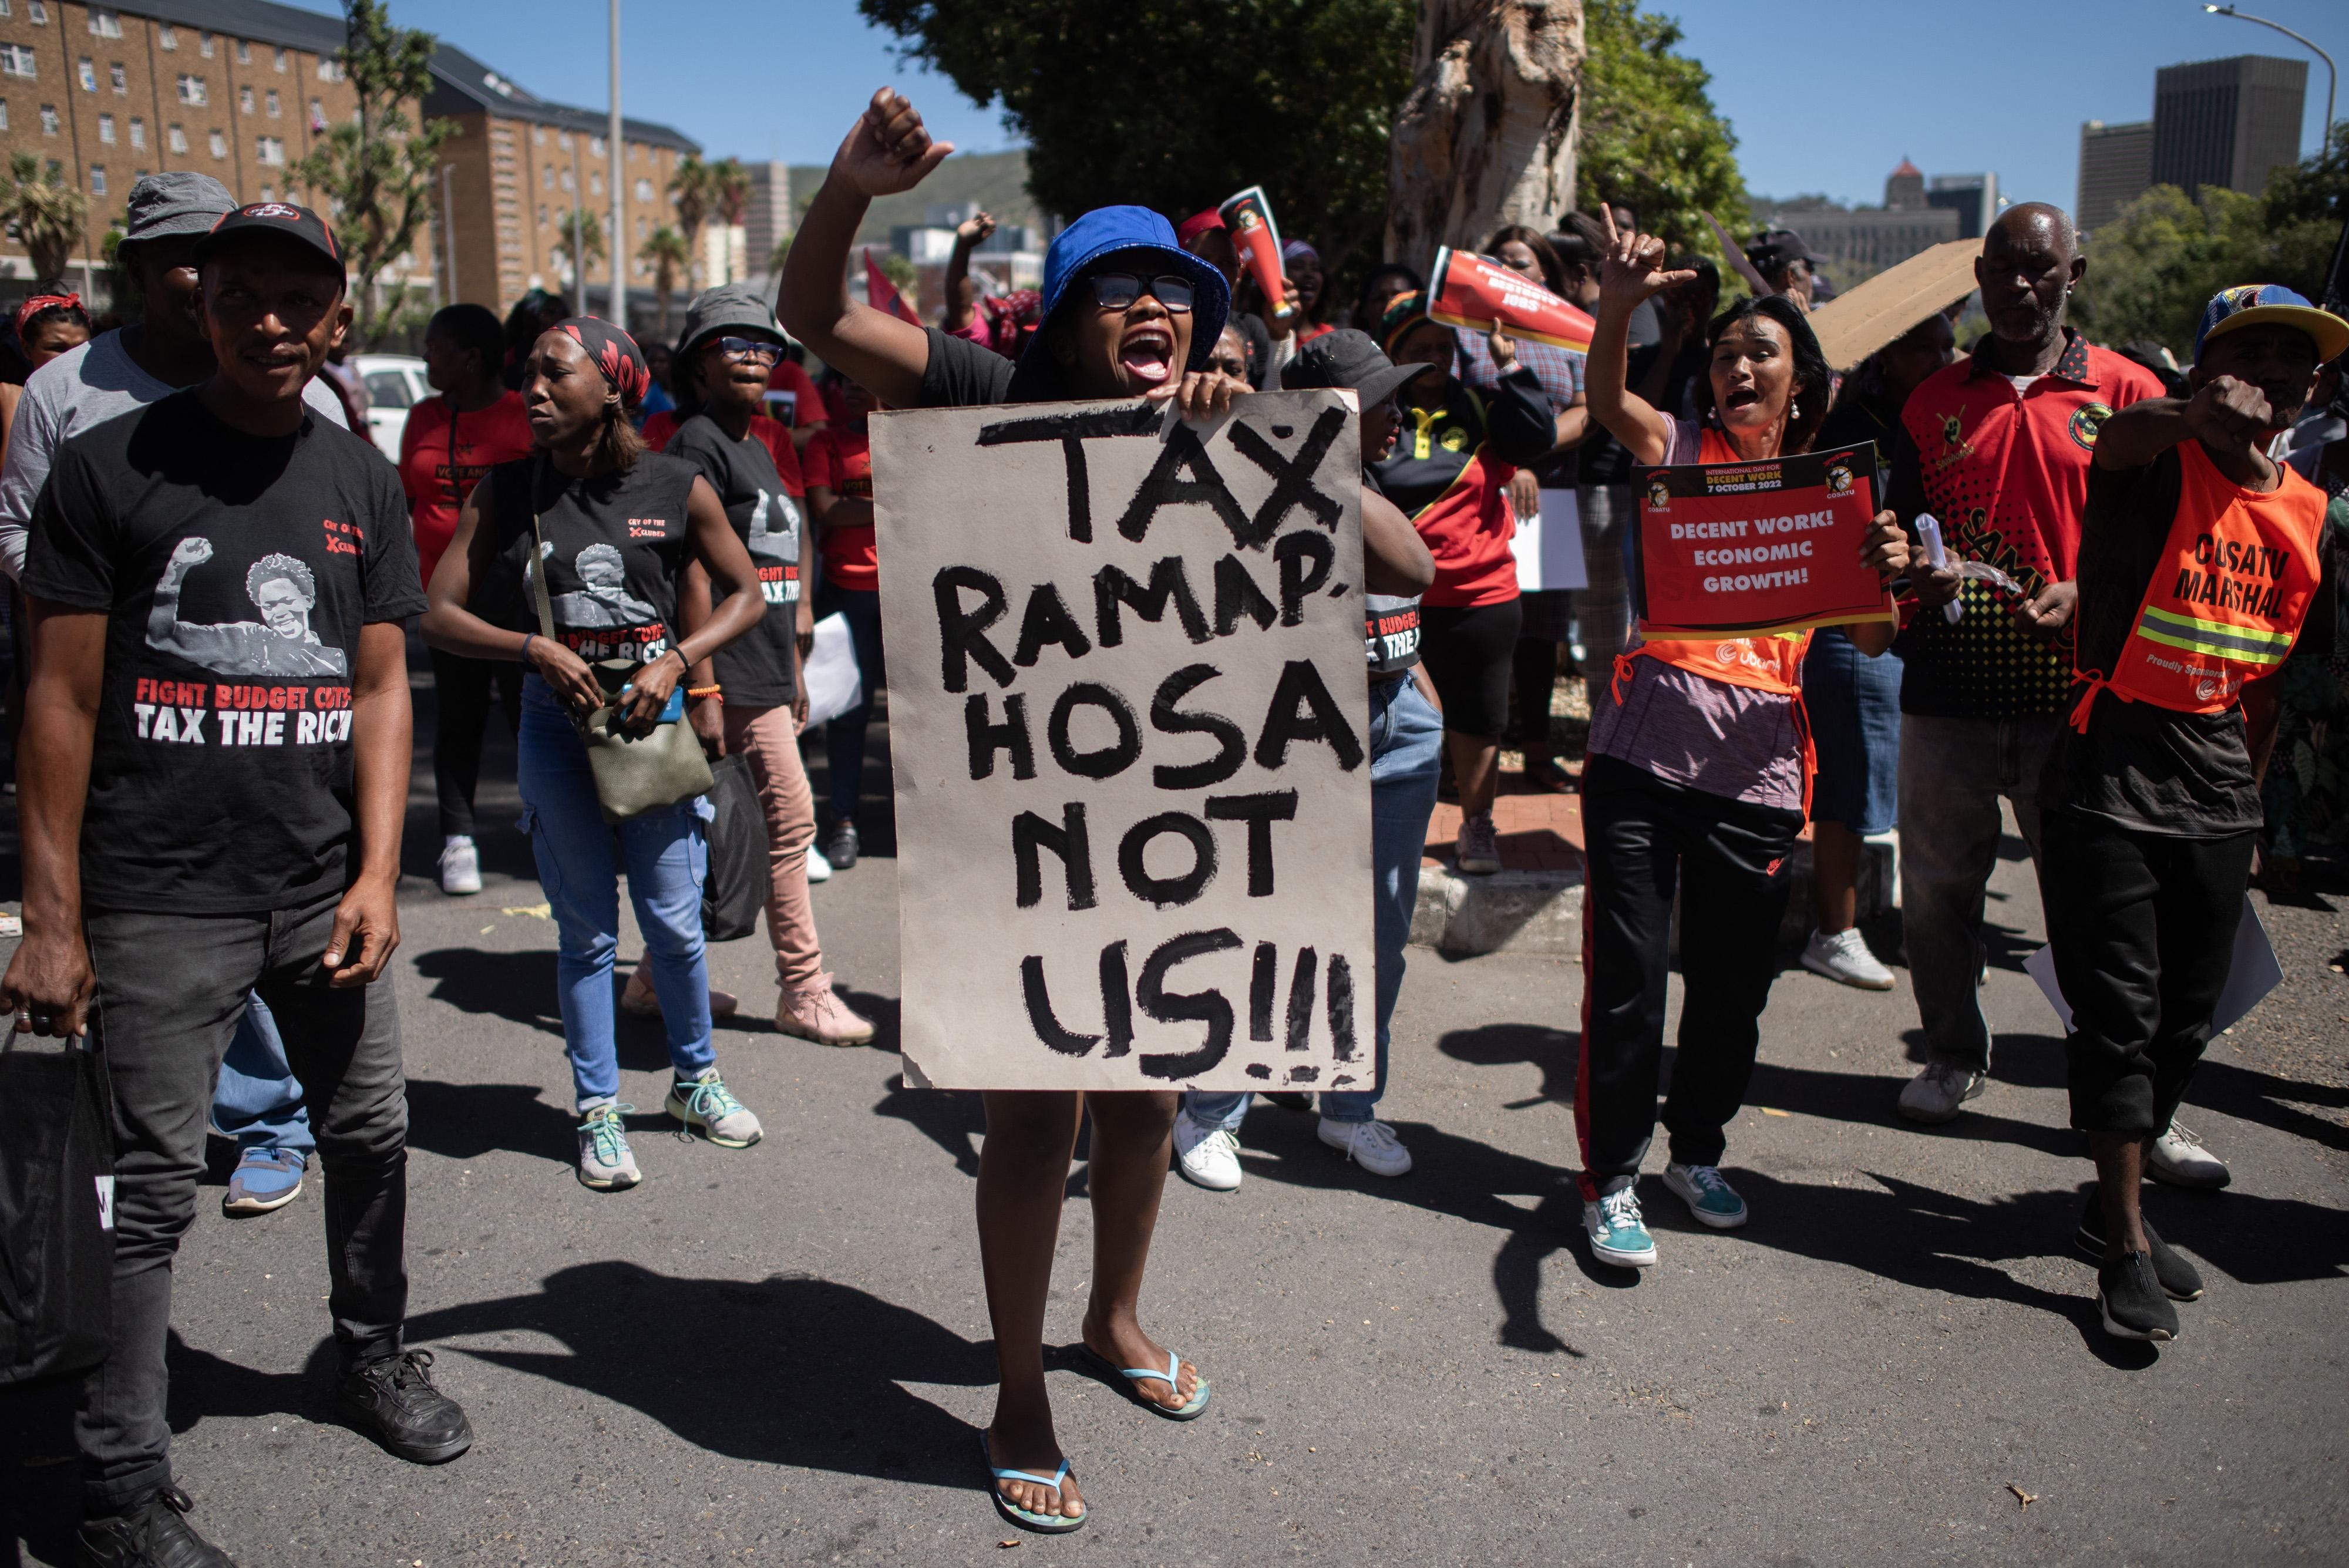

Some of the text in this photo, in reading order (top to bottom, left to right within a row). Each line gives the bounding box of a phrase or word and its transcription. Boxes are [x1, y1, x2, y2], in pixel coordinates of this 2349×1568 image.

[1501, 292, 1540, 313] JOBS
[974, 403, 1347, 553] TAX
[1705, 467, 1752, 476] INTERNATIONAL
[1706, 471, 1782, 484] DECENT WORK
[1715, 482, 1756, 492] OCTOBER
[1758, 479, 1782, 489] 2022
[1826, 489, 1855, 499] COSATU
[652, 519, 665, 527] THE
[1670, 509, 1834, 539] DECENT WORK!
[1694, 540, 1813, 566] ECONOMIC
[2195, 533, 2290, 581] COSATU
[1703, 567, 1809, 593] GROWTH!
[2173, 567, 2284, 619] MARSHAL
[1382, 630, 1414, 659] THE
[2146, 654, 2184, 674] Proudly
[136, 677, 208, 708] FIGHT
[214, 684, 309, 710] BUDGET
[134, 703, 207, 745] TAX
[217, 710, 286, 746] THE
[964, 658, 1365, 790] HOSA
[1012, 788, 1298, 911] NOT
[1020, 927, 1366, 1087] US!!!
[594, 1108, 605, 1118] NIKE
